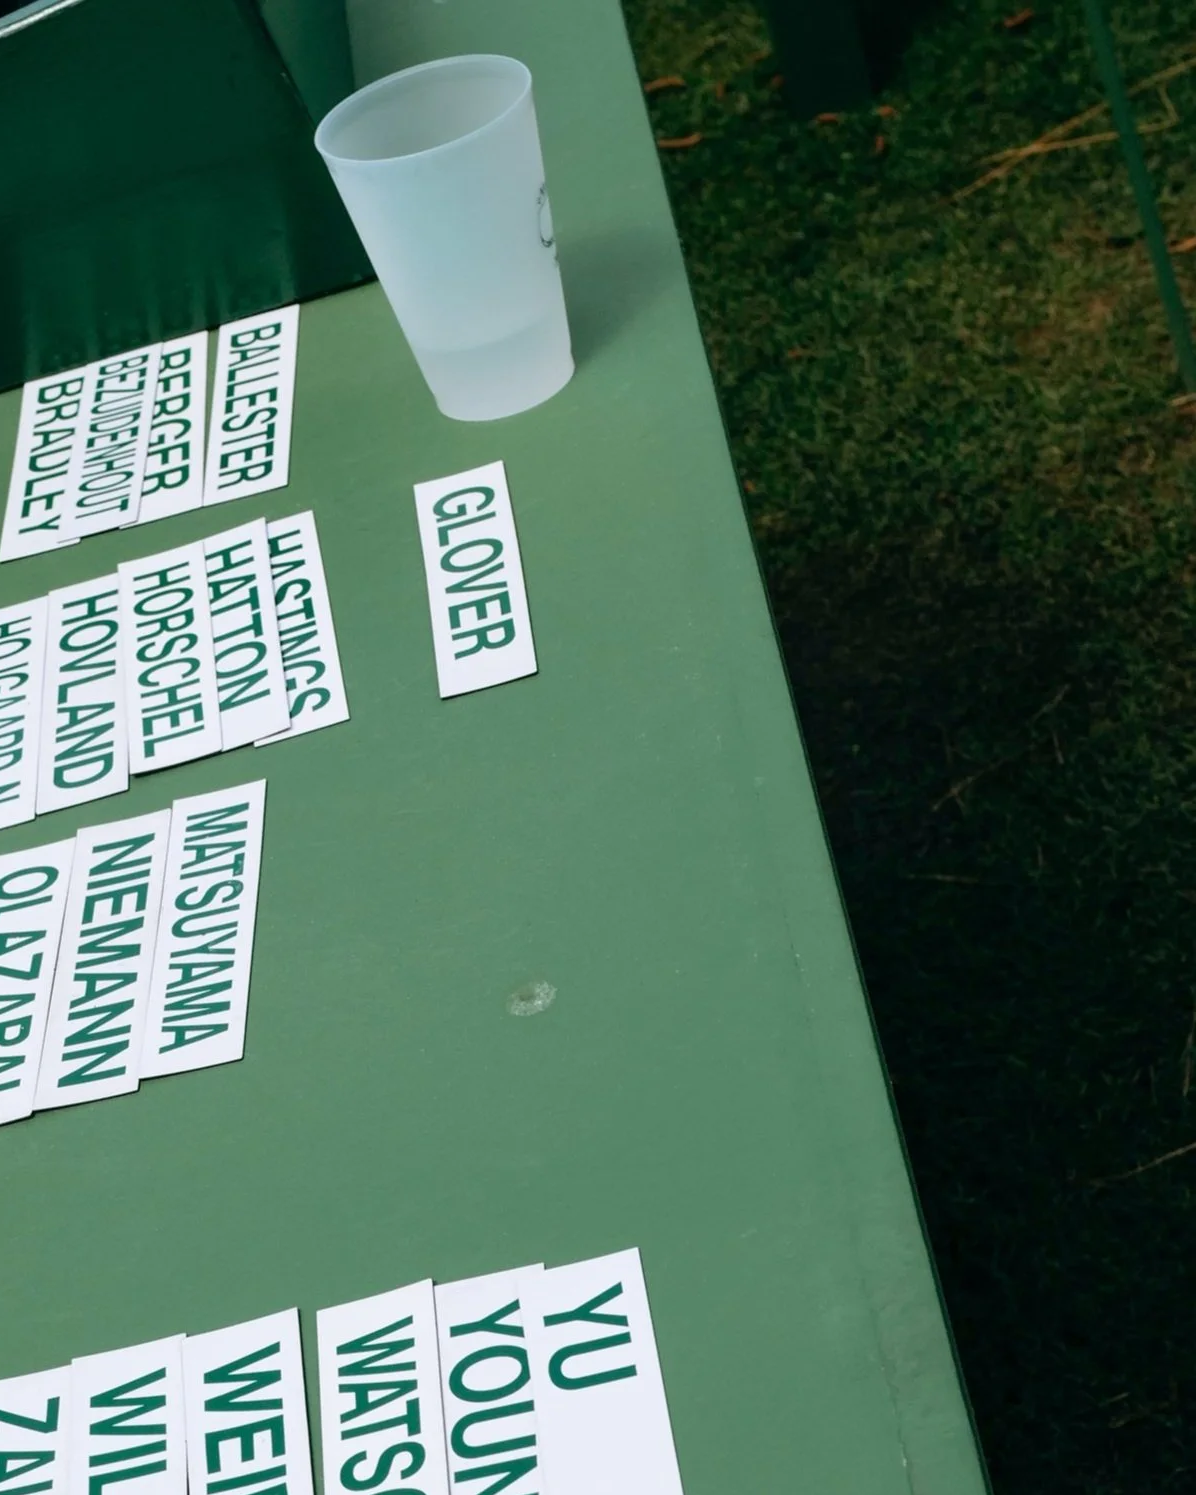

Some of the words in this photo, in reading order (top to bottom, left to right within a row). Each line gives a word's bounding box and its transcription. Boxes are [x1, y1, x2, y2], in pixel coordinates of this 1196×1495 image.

[19, 382, 84, 536] BRADLEY
[76, 357, 149, 515] BEZUIDENHOUT
[219, 323, 281, 488] BALLESTER
[205, 545, 269, 708] HATTON
[268, 530, 330, 718] HASTINGS
[434, 487, 515, 659] GLOVER
[52, 595, 119, 789] HOVLAND
[134, 562, 204, 757] HORSCHEL
[58, 834, 154, 1087] NIEMANN
[160, 803, 248, 1053] MATSUYAMA
[541, 1282, 637, 1393] YU
